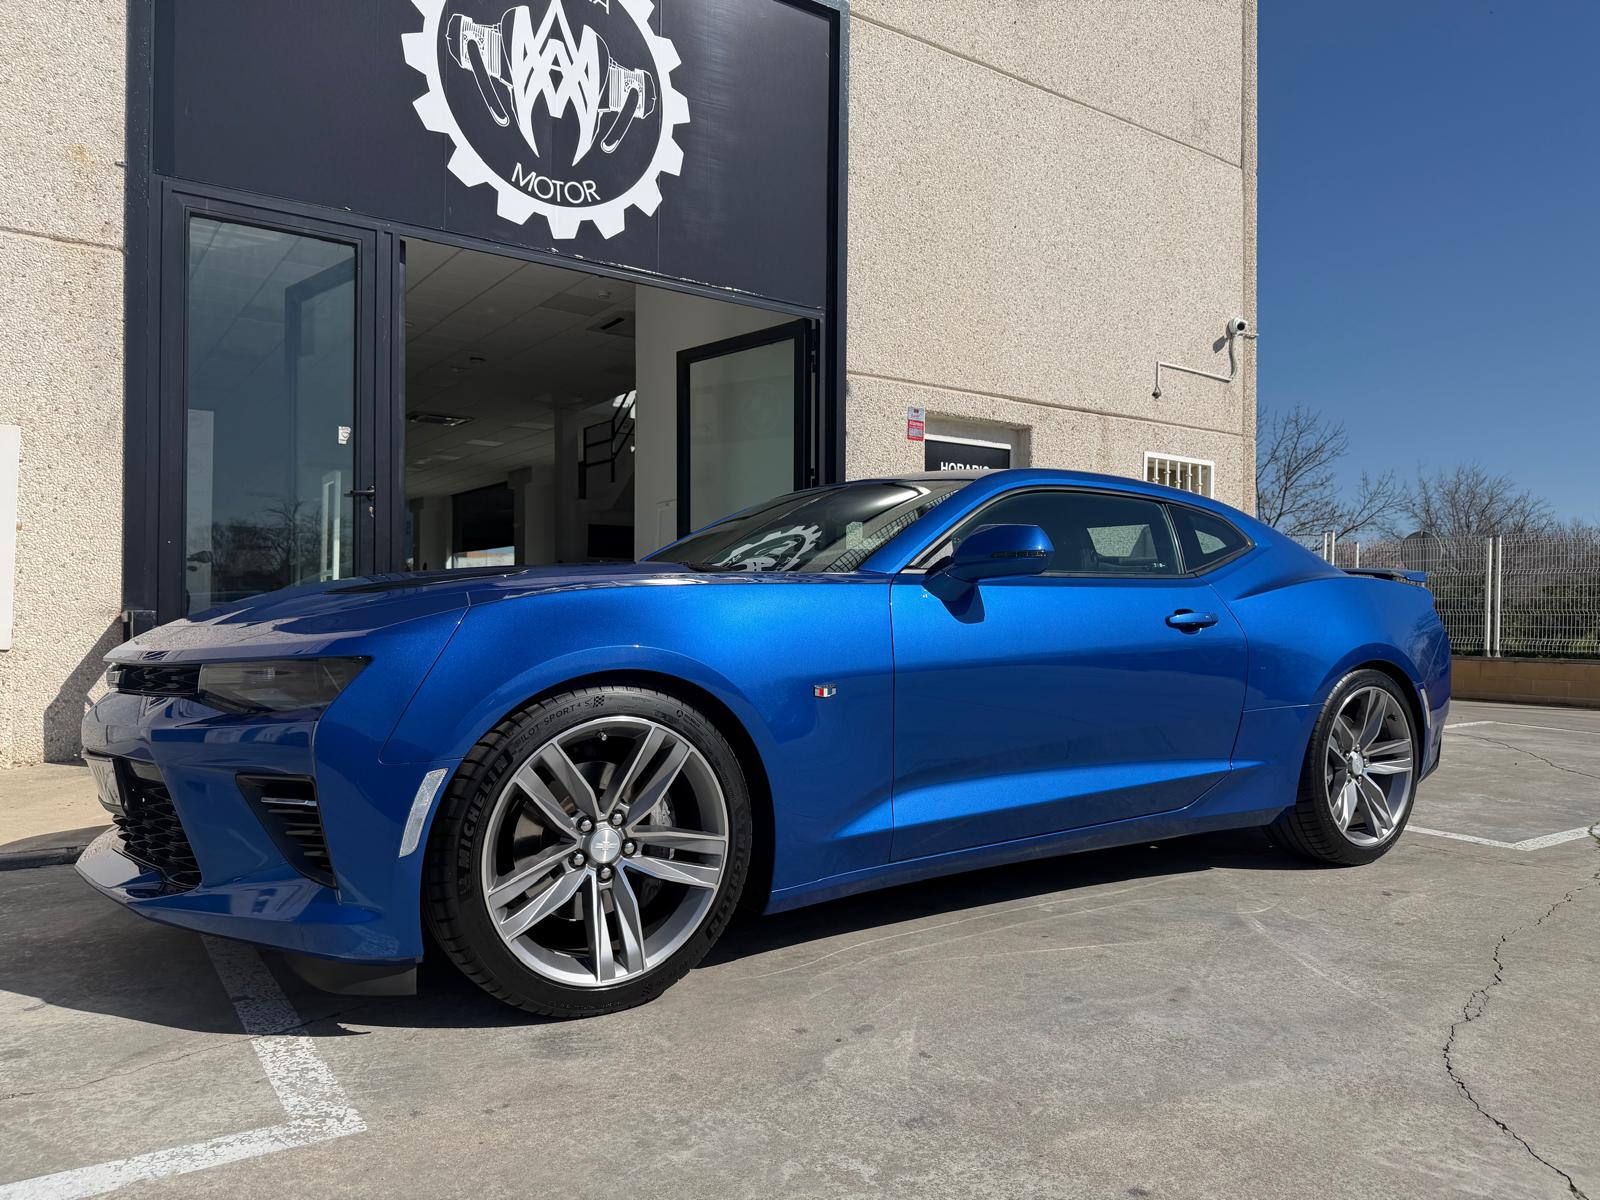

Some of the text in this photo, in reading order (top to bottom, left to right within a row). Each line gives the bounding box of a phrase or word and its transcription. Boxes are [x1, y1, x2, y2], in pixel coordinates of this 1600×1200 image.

[511, 162, 600, 204] MOTOR
[515, 724, 540, 746] PILOT
[543, 704, 576, 726] SPORT
[458, 755, 509, 869] MICHELIN
